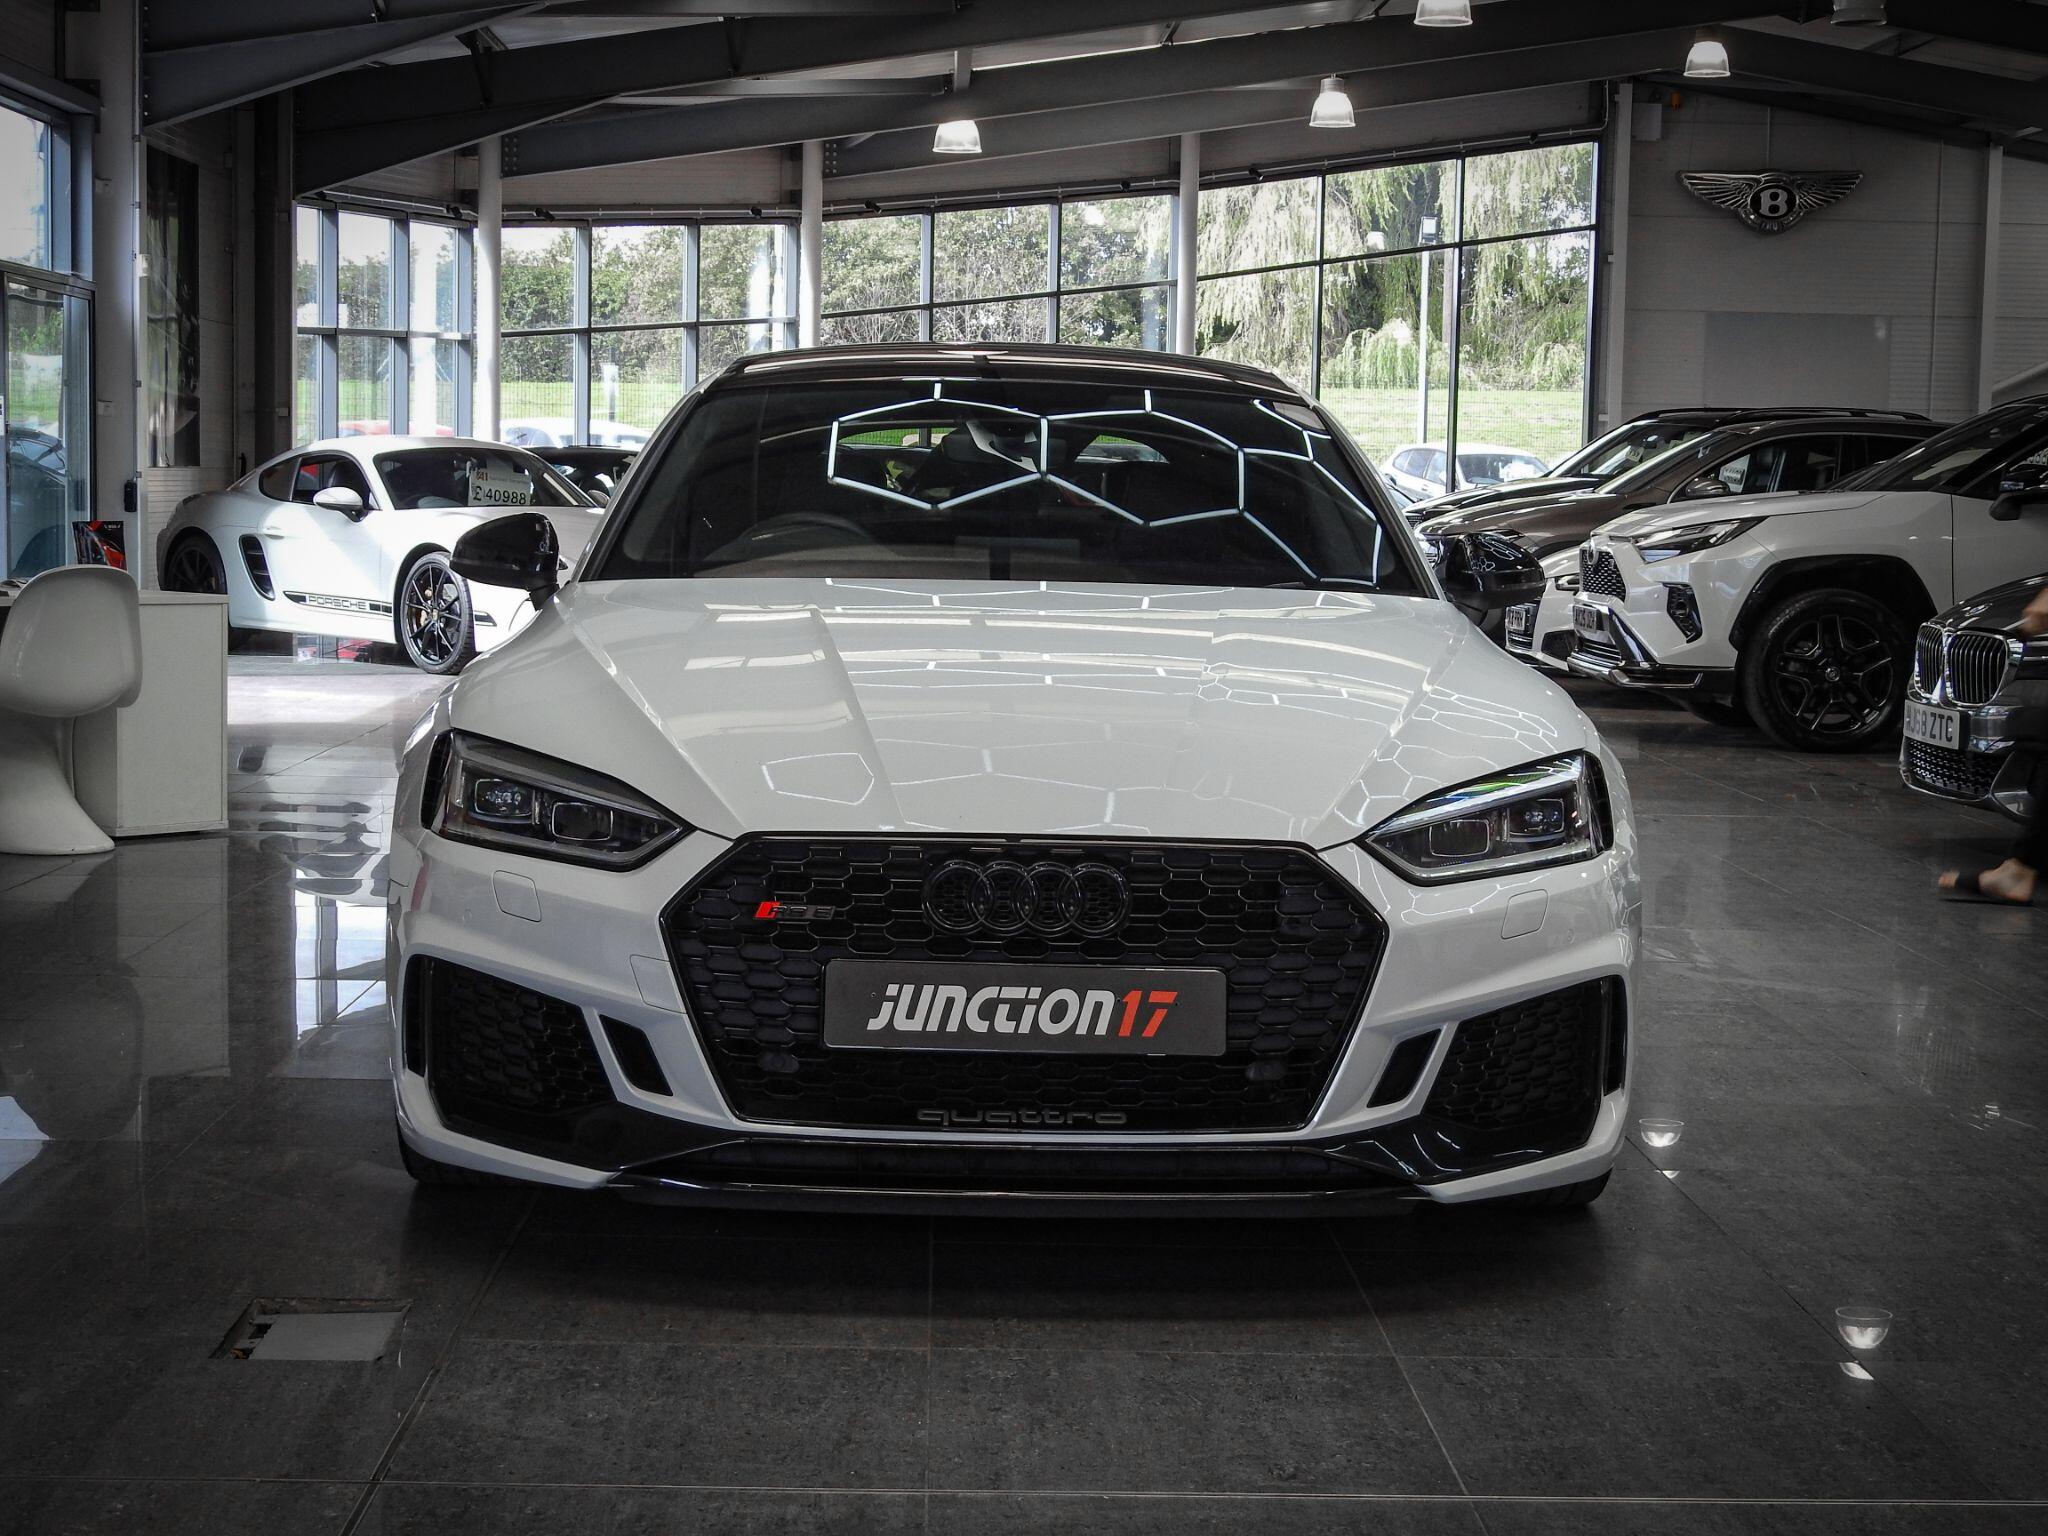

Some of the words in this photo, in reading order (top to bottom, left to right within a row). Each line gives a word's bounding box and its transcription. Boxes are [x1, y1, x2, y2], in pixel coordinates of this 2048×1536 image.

[308, 595, 368, 610] PORSCHE
[1929, 711, 1954, 743] ZTC
[916, 1107, 1128, 1126] quattro
